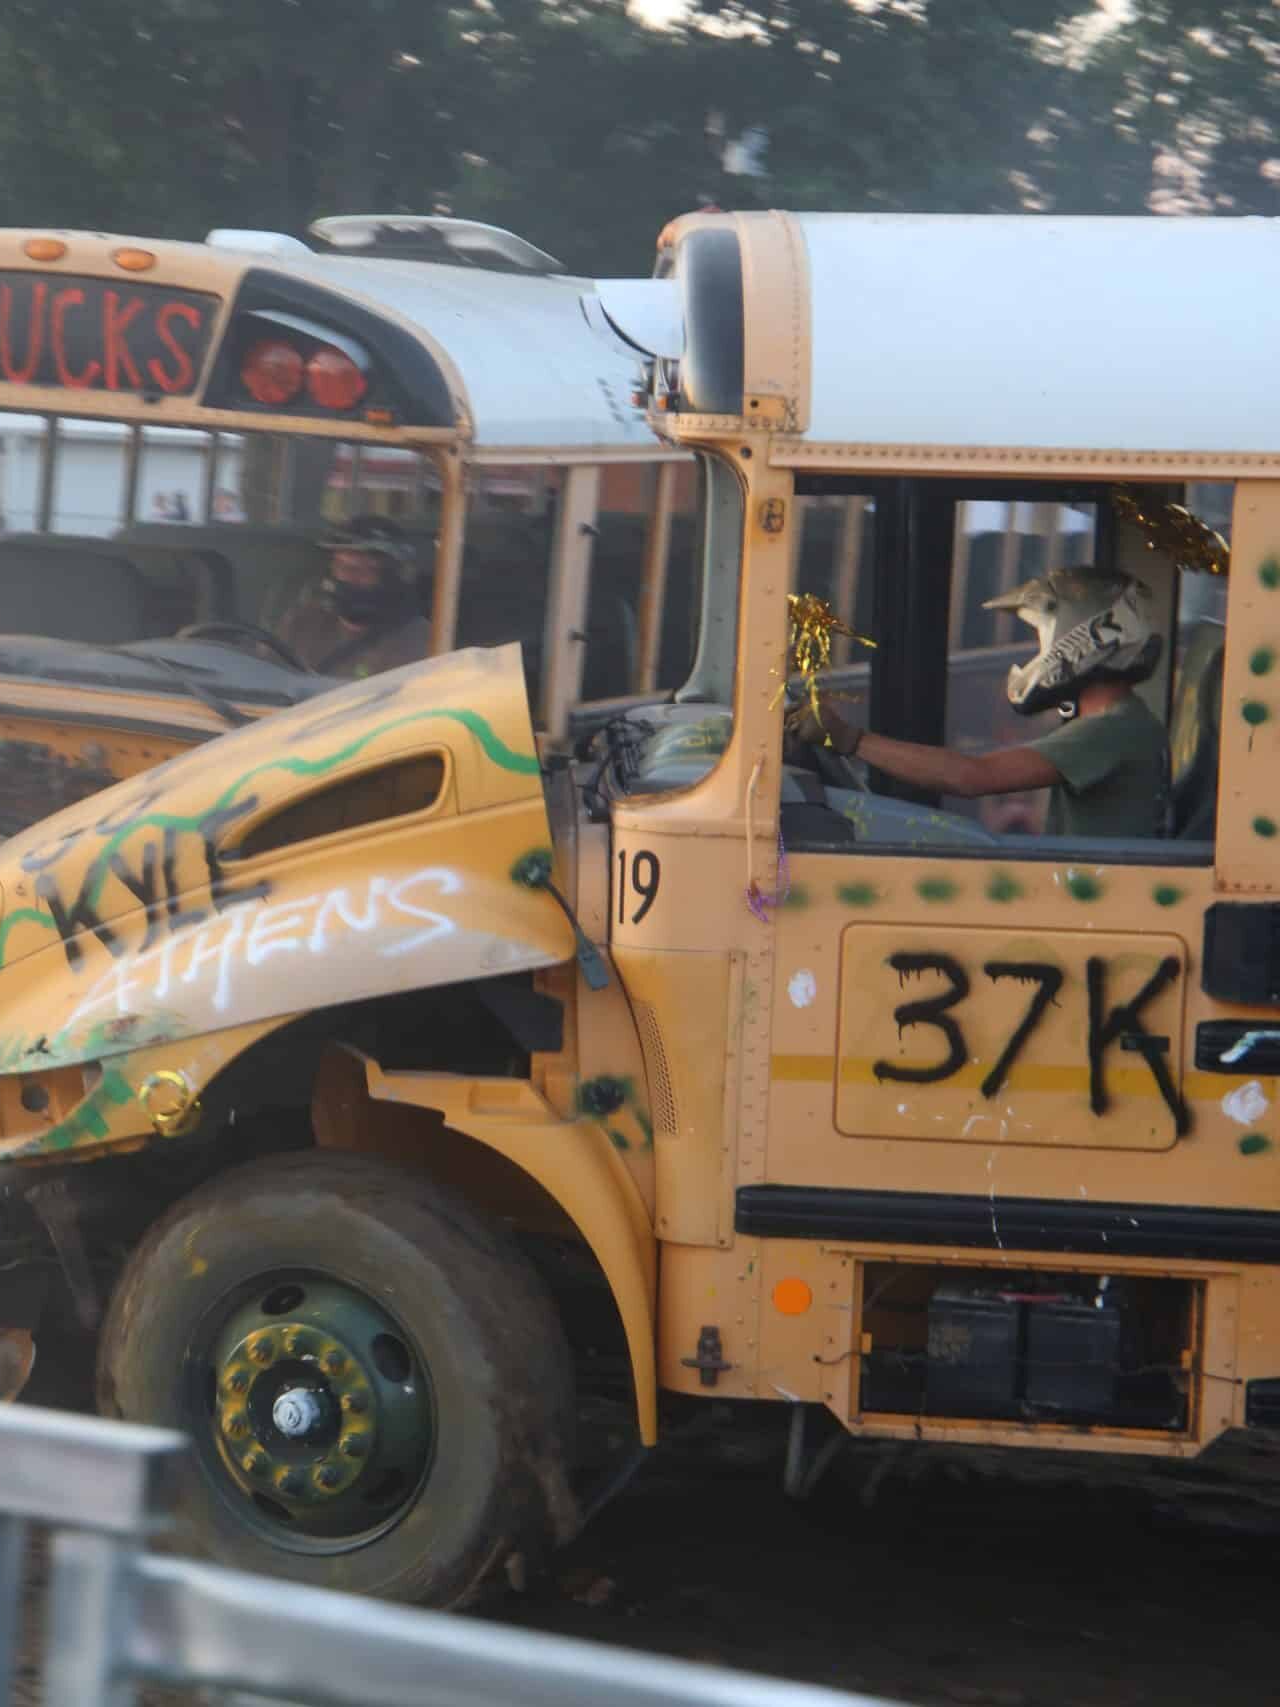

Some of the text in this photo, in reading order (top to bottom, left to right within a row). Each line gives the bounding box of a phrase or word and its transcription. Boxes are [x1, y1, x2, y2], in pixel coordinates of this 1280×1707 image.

[35, 795, 273, 974] KYLE
[53, 866, 465, 1042] ATHENS
[616, 848, 661, 925] 19
[871, 949, 1194, 1139] 37K
